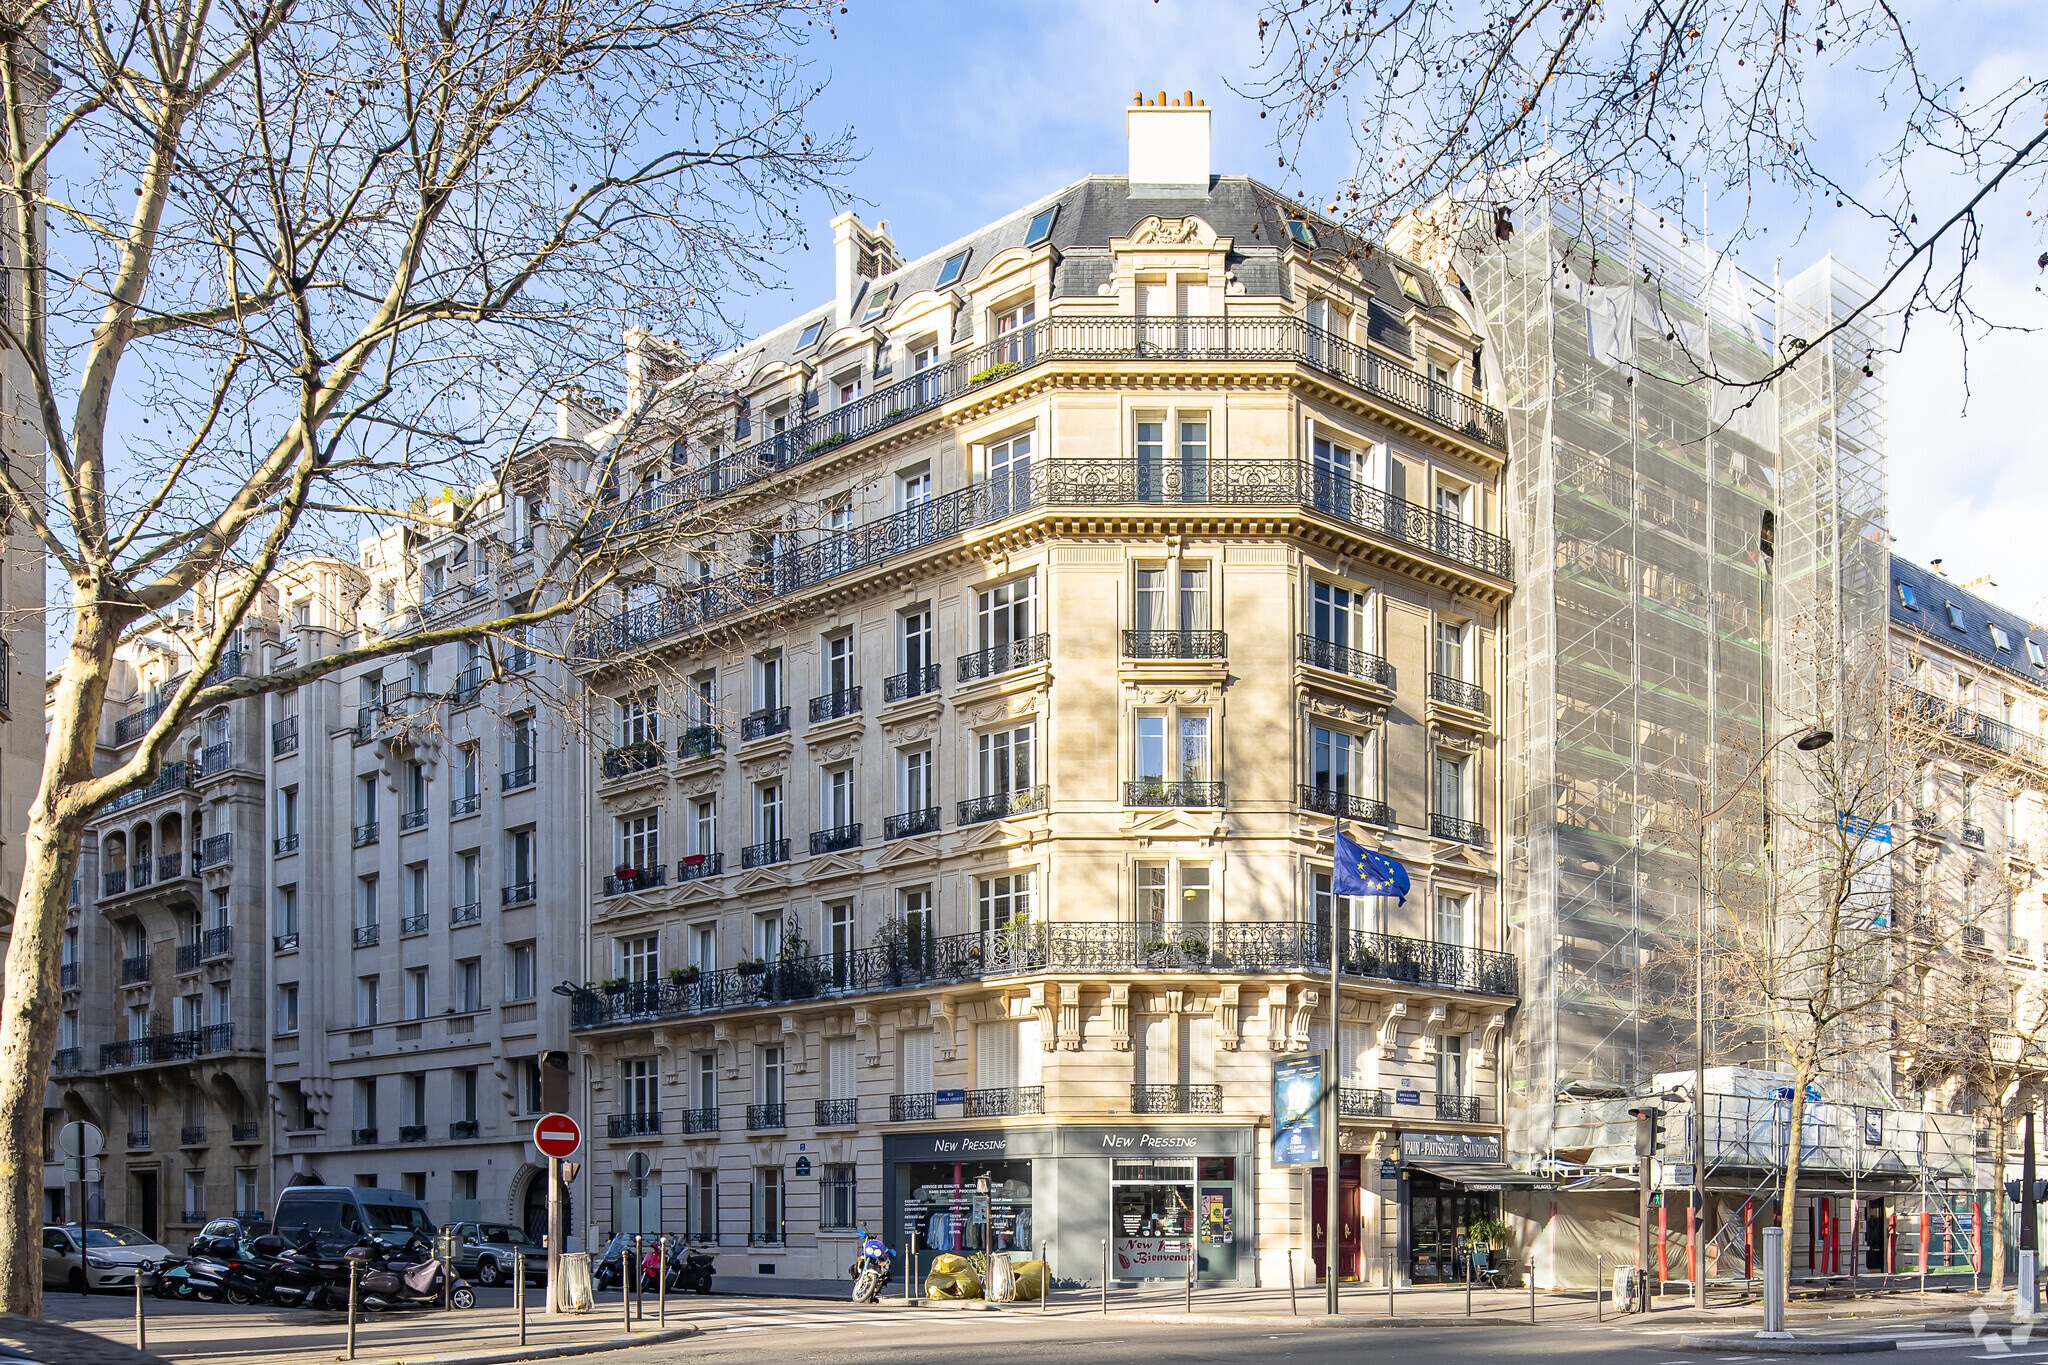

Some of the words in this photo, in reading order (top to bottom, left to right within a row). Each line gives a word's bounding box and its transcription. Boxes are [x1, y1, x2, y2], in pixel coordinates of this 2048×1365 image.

[1405, 1141, 1420, 1155] PAIN
[1424, 1141, 1460, 1157] PATISSERIE
[1463, 1143, 1499, 1158] SANDWICHS
[1118, 1239, 1153, 1252] New
[1157, 1239, 1193, 1253] Pss
